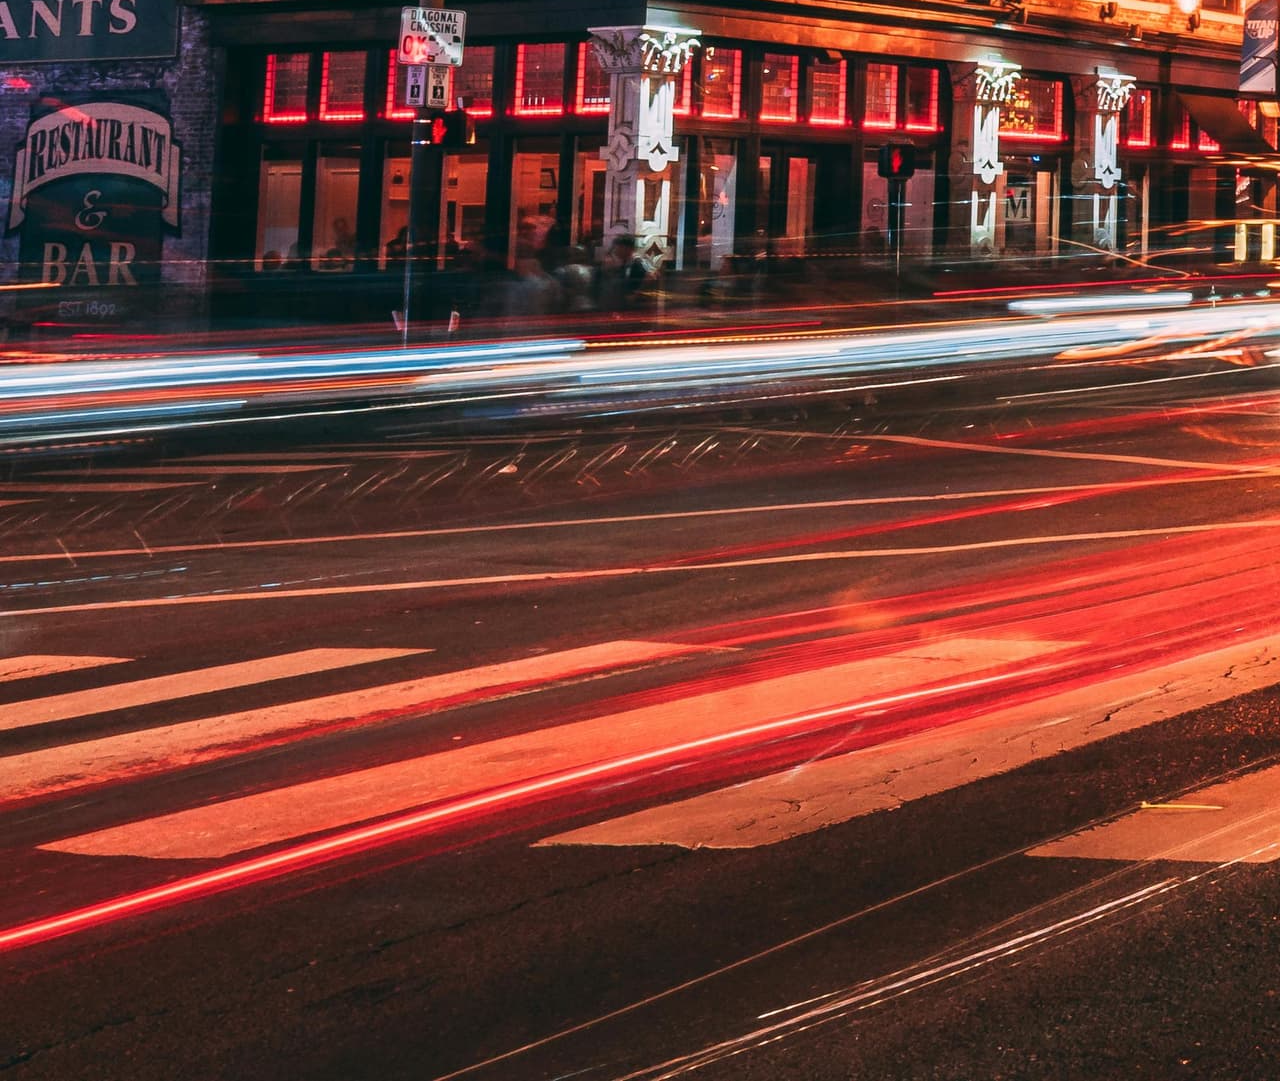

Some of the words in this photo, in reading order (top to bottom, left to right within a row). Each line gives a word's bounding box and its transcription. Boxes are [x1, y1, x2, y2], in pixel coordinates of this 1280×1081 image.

[410, 10, 458, 23] DIAGONAL
[410, 21, 458, 35] CROSSING
[27, 117, 167, 183] RESTAURANT
[75, 190, 108, 231] &
[42, 241, 138, 287] BAR
